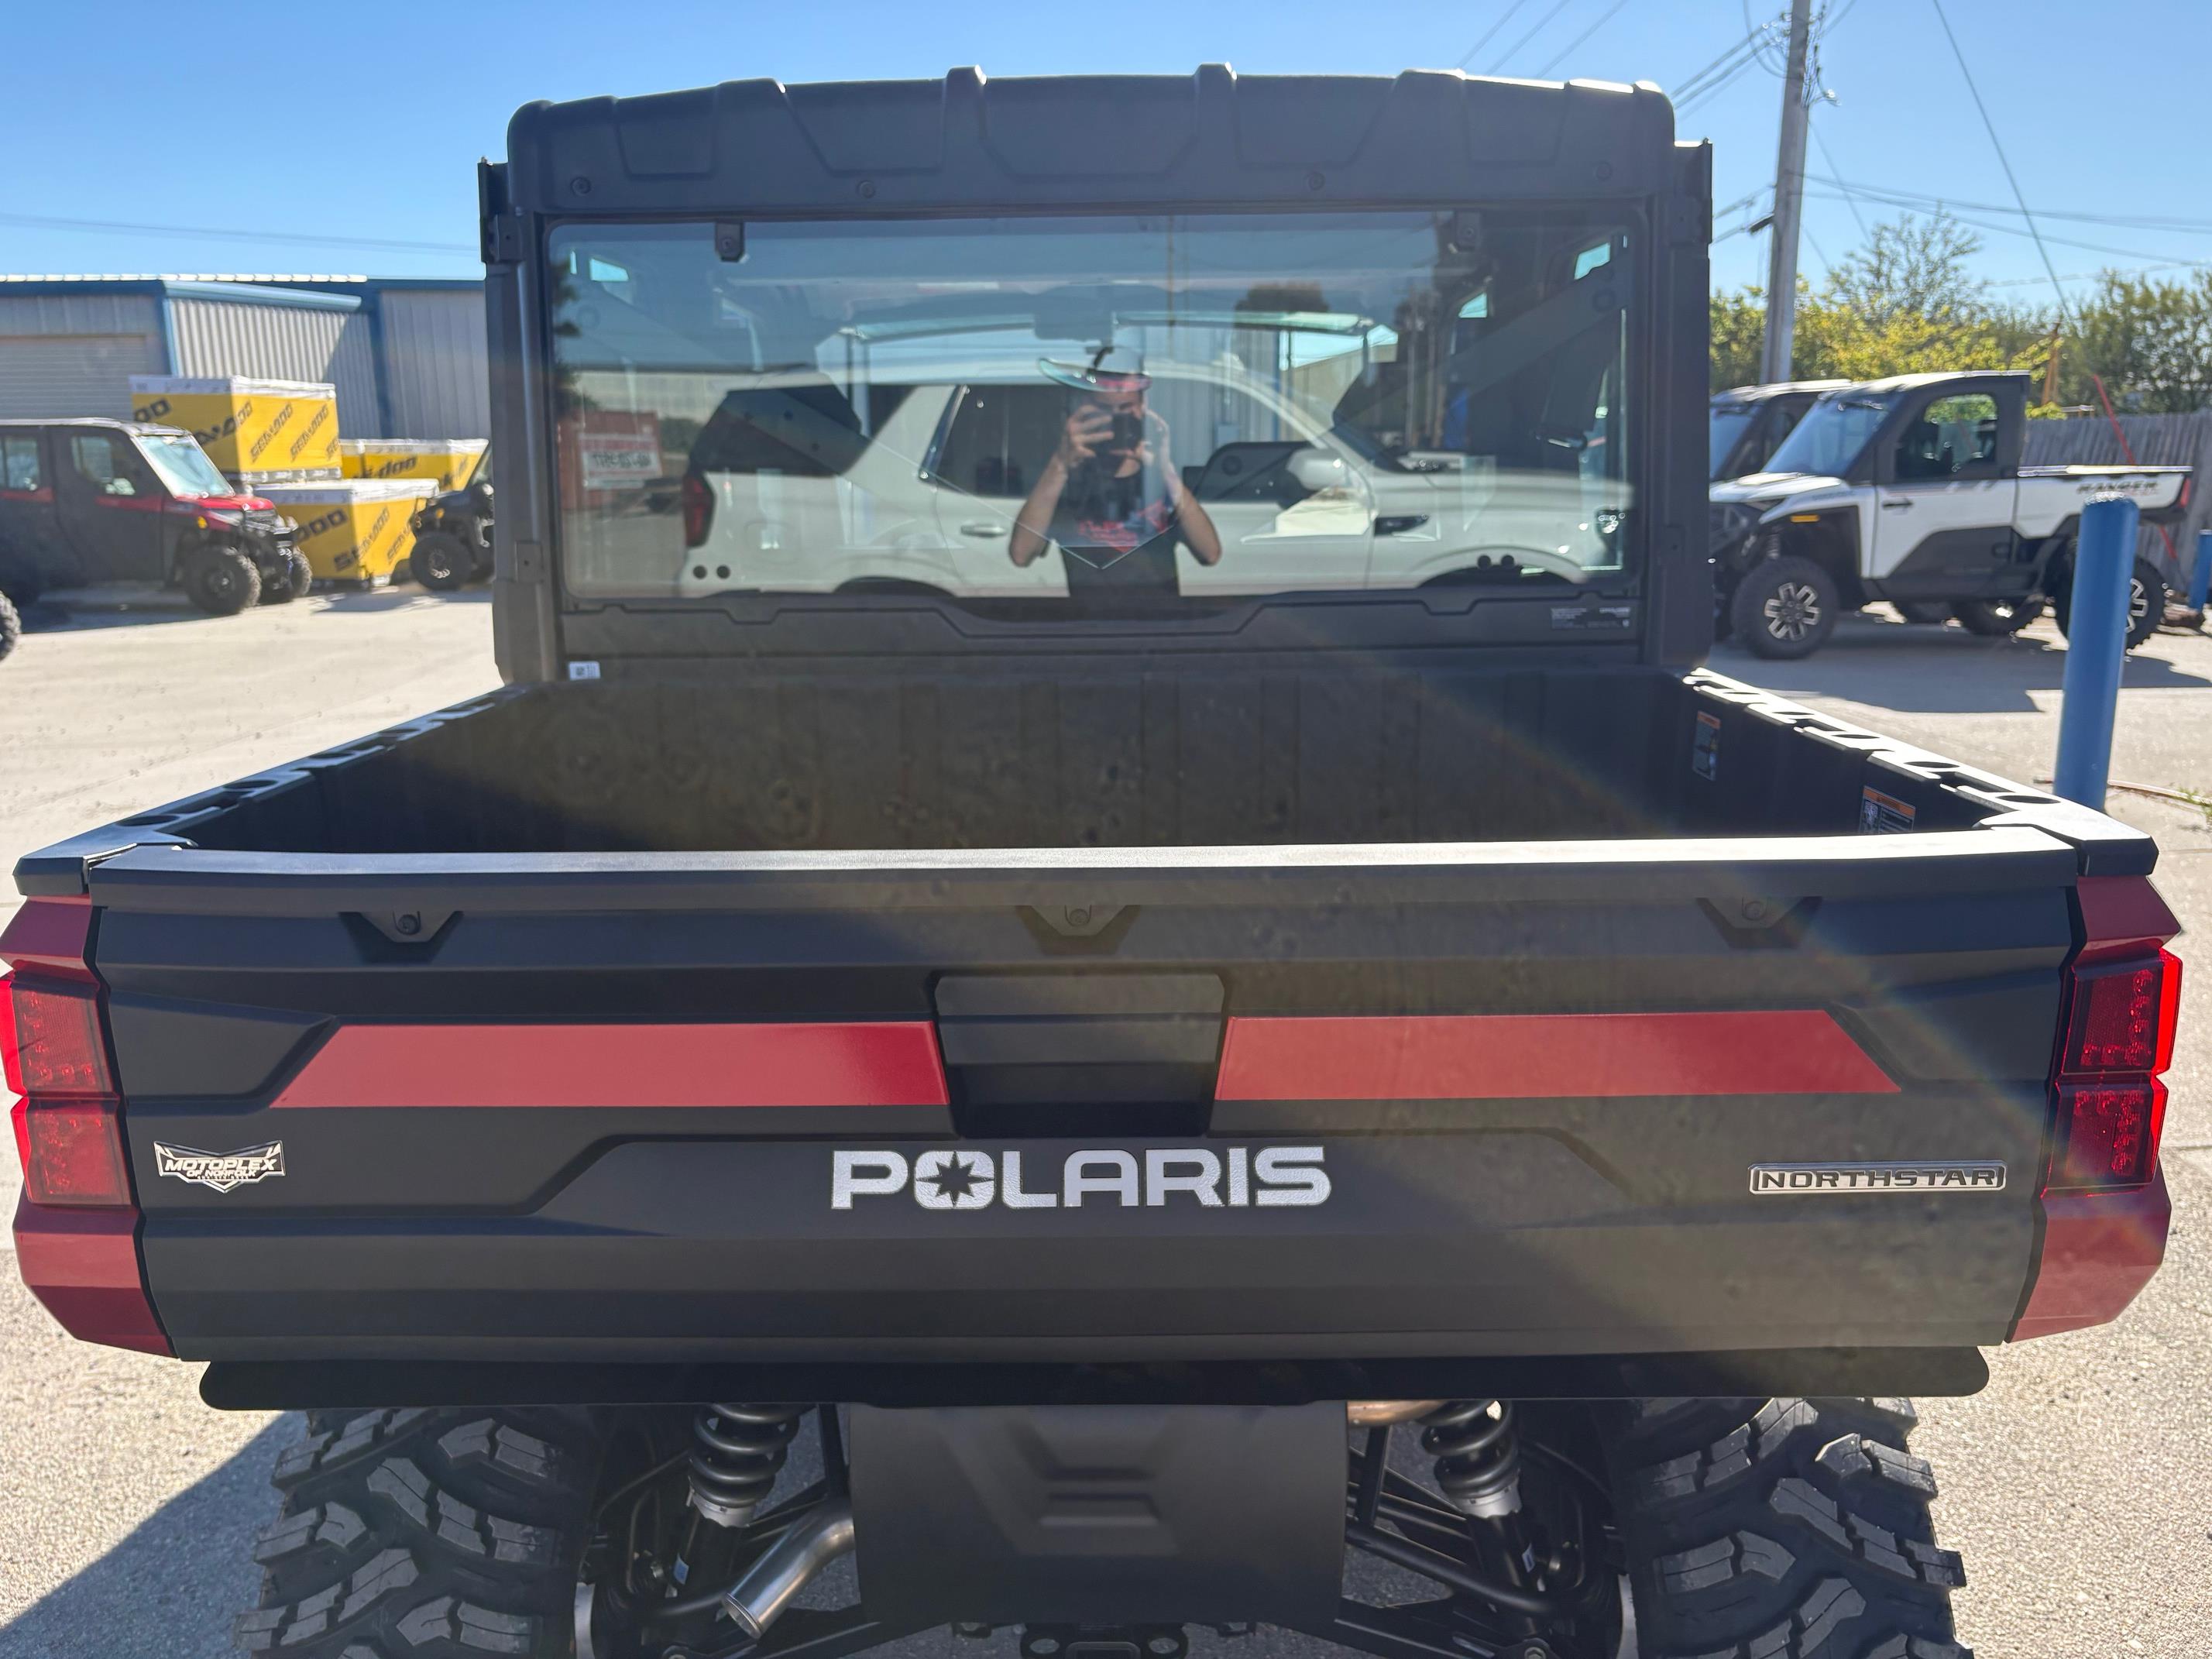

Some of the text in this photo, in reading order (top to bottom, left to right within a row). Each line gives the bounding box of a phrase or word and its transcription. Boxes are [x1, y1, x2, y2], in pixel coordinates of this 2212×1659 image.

[165, 1159, 277, 1171] MOTOPLEX
[204, 1169, 257, 1177] NORFOLK
[831, 1146, 1332, 1210] POLARIS
[1760, 1168, 1997, 1189] NORTHSTAR
